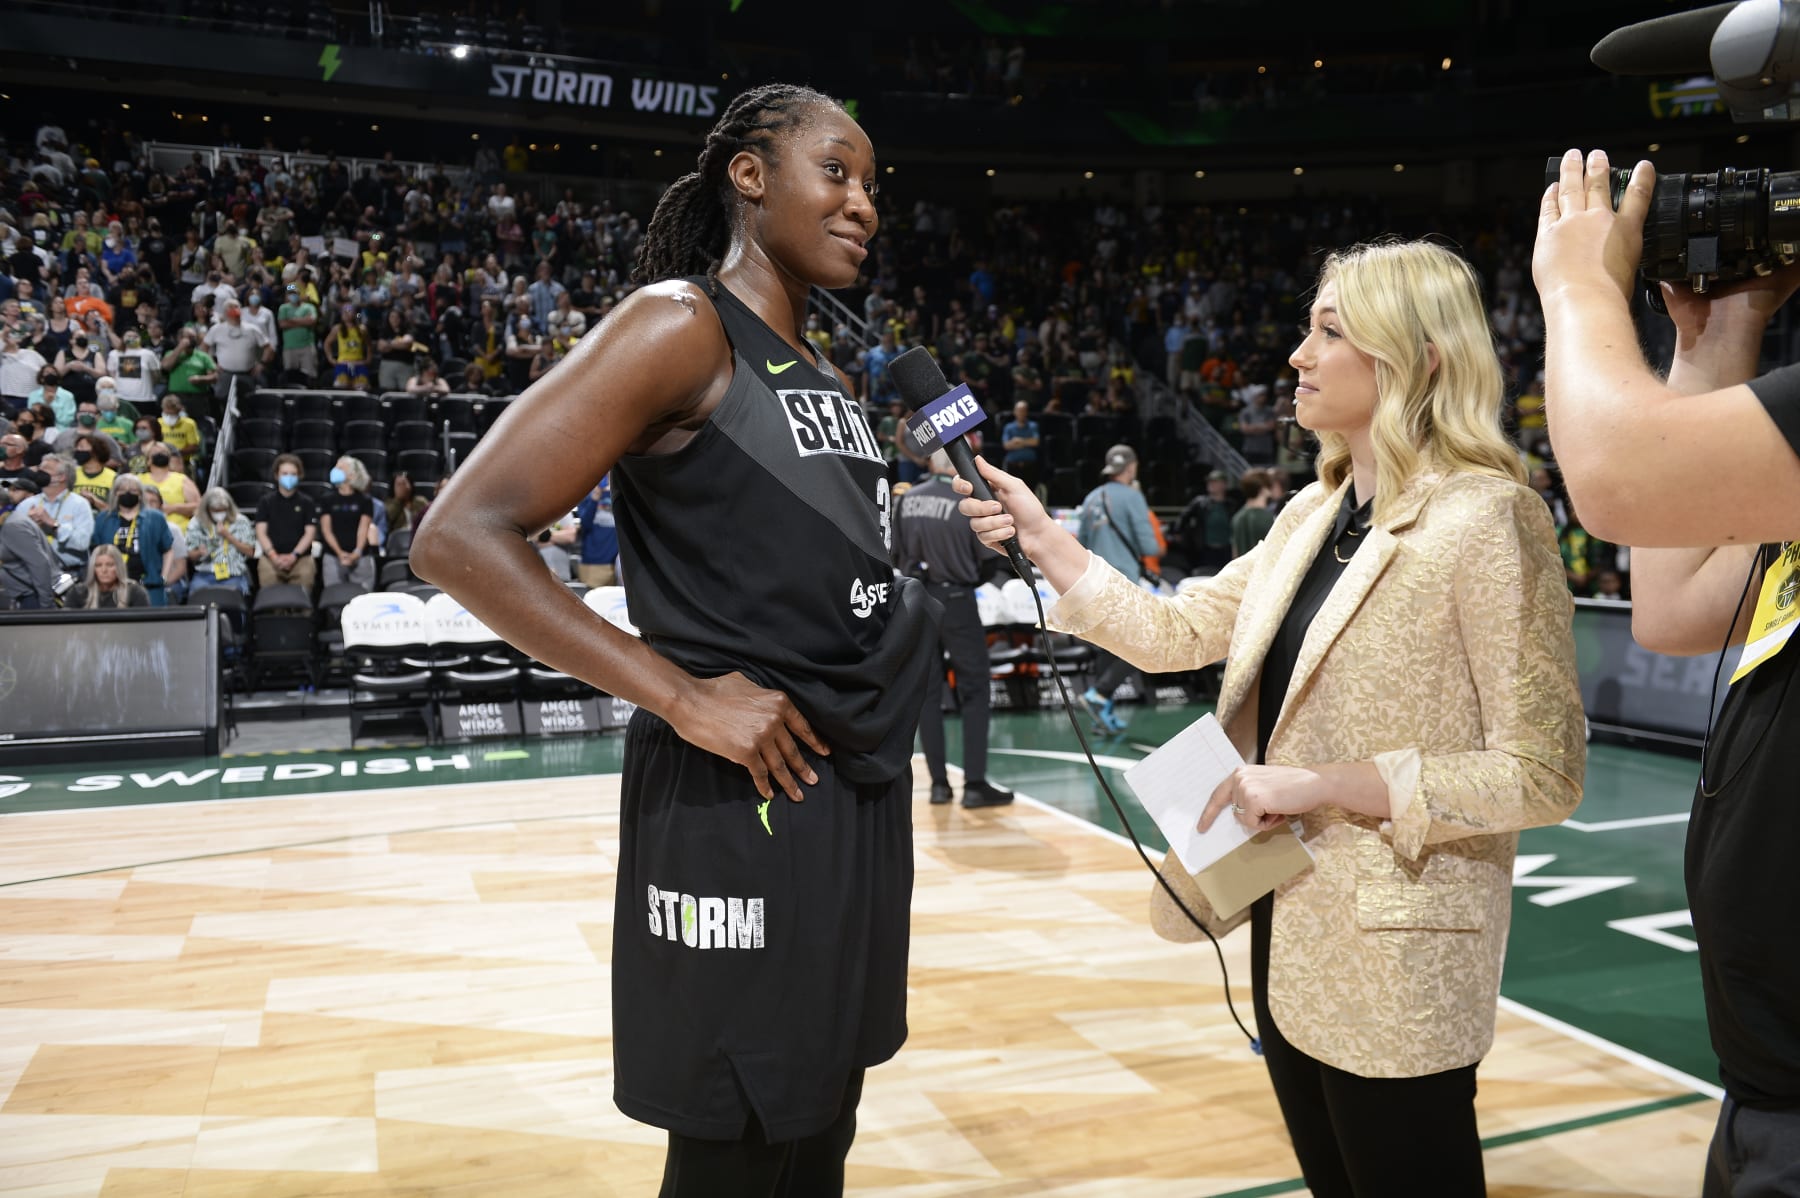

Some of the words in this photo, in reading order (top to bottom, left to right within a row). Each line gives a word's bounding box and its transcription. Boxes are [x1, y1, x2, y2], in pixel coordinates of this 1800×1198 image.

[488, 64, 613, 107] STORM
[631, 78, 719, 117] WINS
[901, 494, 957, 521] SECURITY
[1782, 544, 1800, 567] PH
[351, 619, 421, 630] SYMETRA
[459, 702, 503, 717] ANGEL
[540, 700, 583, 713] ANGEL
[459, 716, 505, 731] WINDS
[540, 714, 585, 728] WINDS
[66, 753, 472, 792] SWEDISH
[647, 884, 765, 949] STORM
